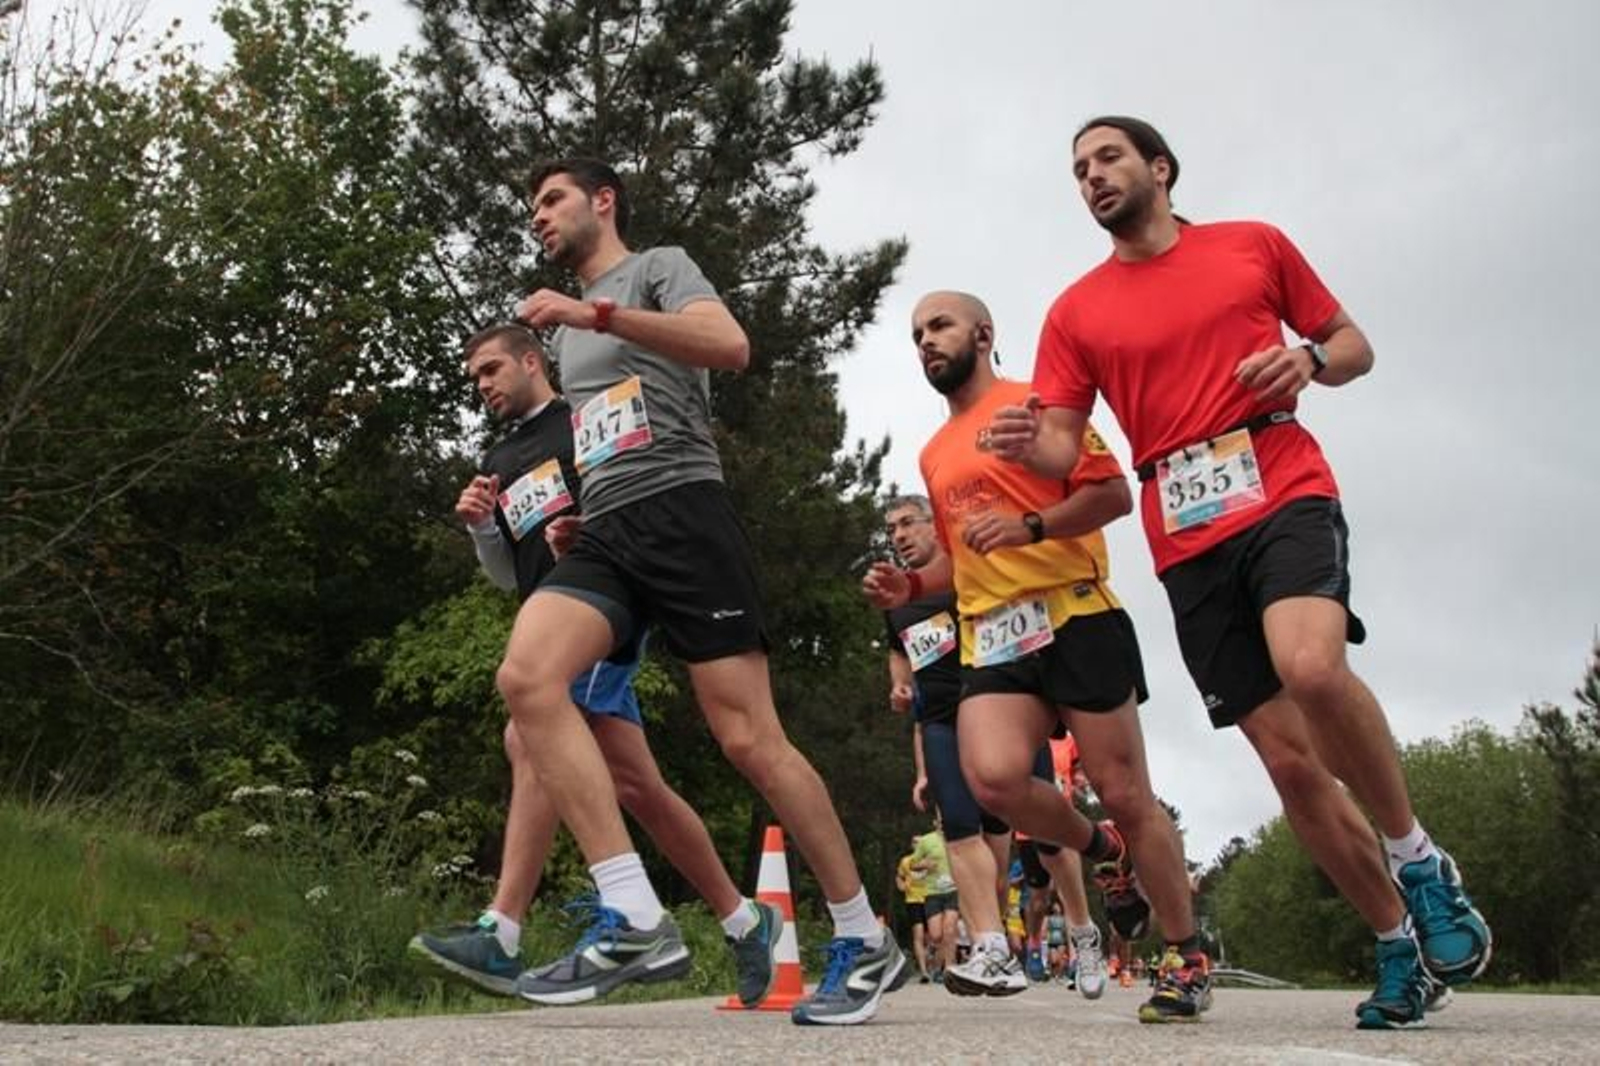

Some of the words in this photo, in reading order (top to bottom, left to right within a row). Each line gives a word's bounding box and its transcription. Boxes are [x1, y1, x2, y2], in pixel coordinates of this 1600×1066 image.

[579, 409, 622, 455] 247
[509, 485, 548, 527] 328
[1168, 463, 1232, 510] 355
[981, 611, 1027, 652] 370
